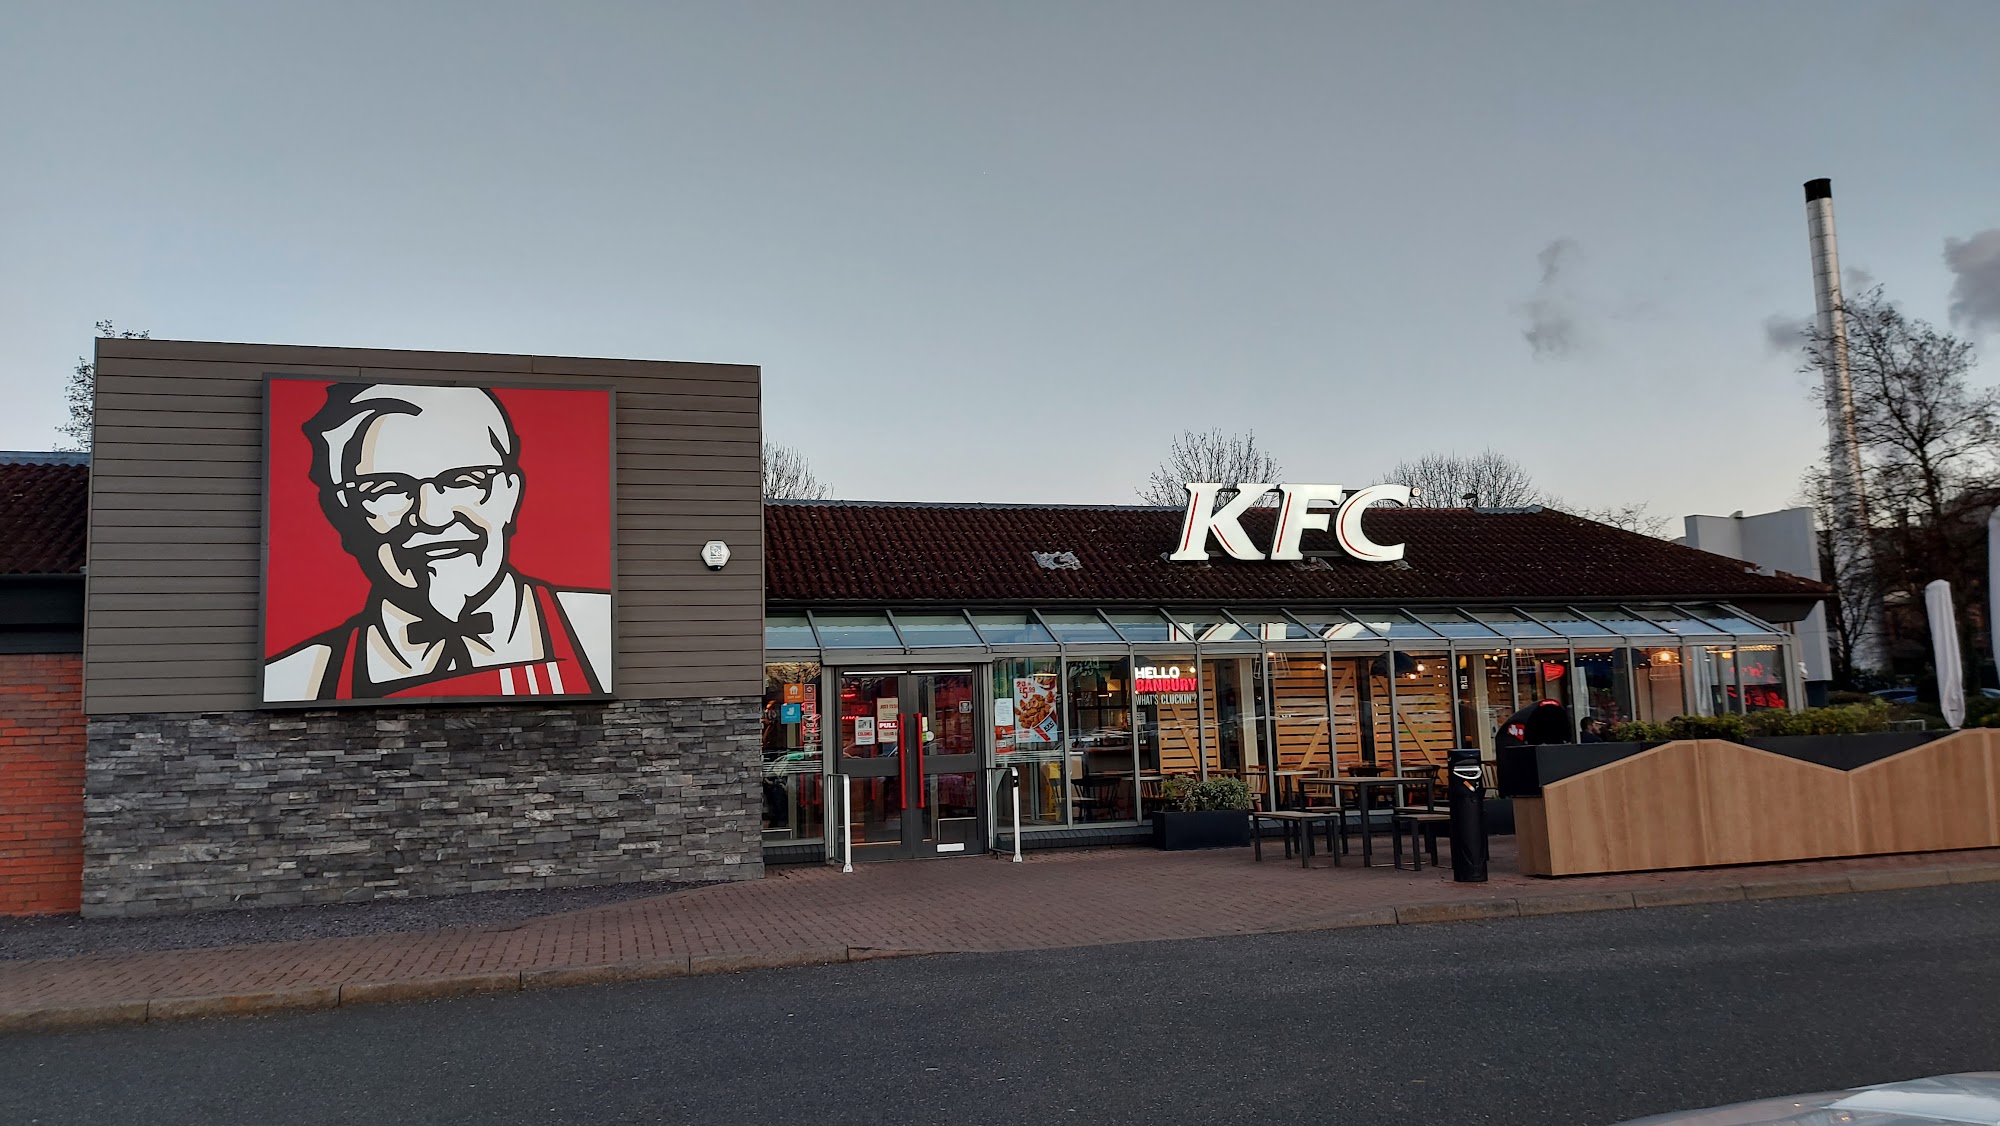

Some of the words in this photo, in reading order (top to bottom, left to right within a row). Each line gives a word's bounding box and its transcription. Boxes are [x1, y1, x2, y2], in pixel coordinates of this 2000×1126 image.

[1170, 483, 1412, 562] KFC
[1135, 666, 1180, 679] HELLO
[1136, 678, 1197, 692] BANBURY
[1136, 694, 1159, 705] WHAT'S
